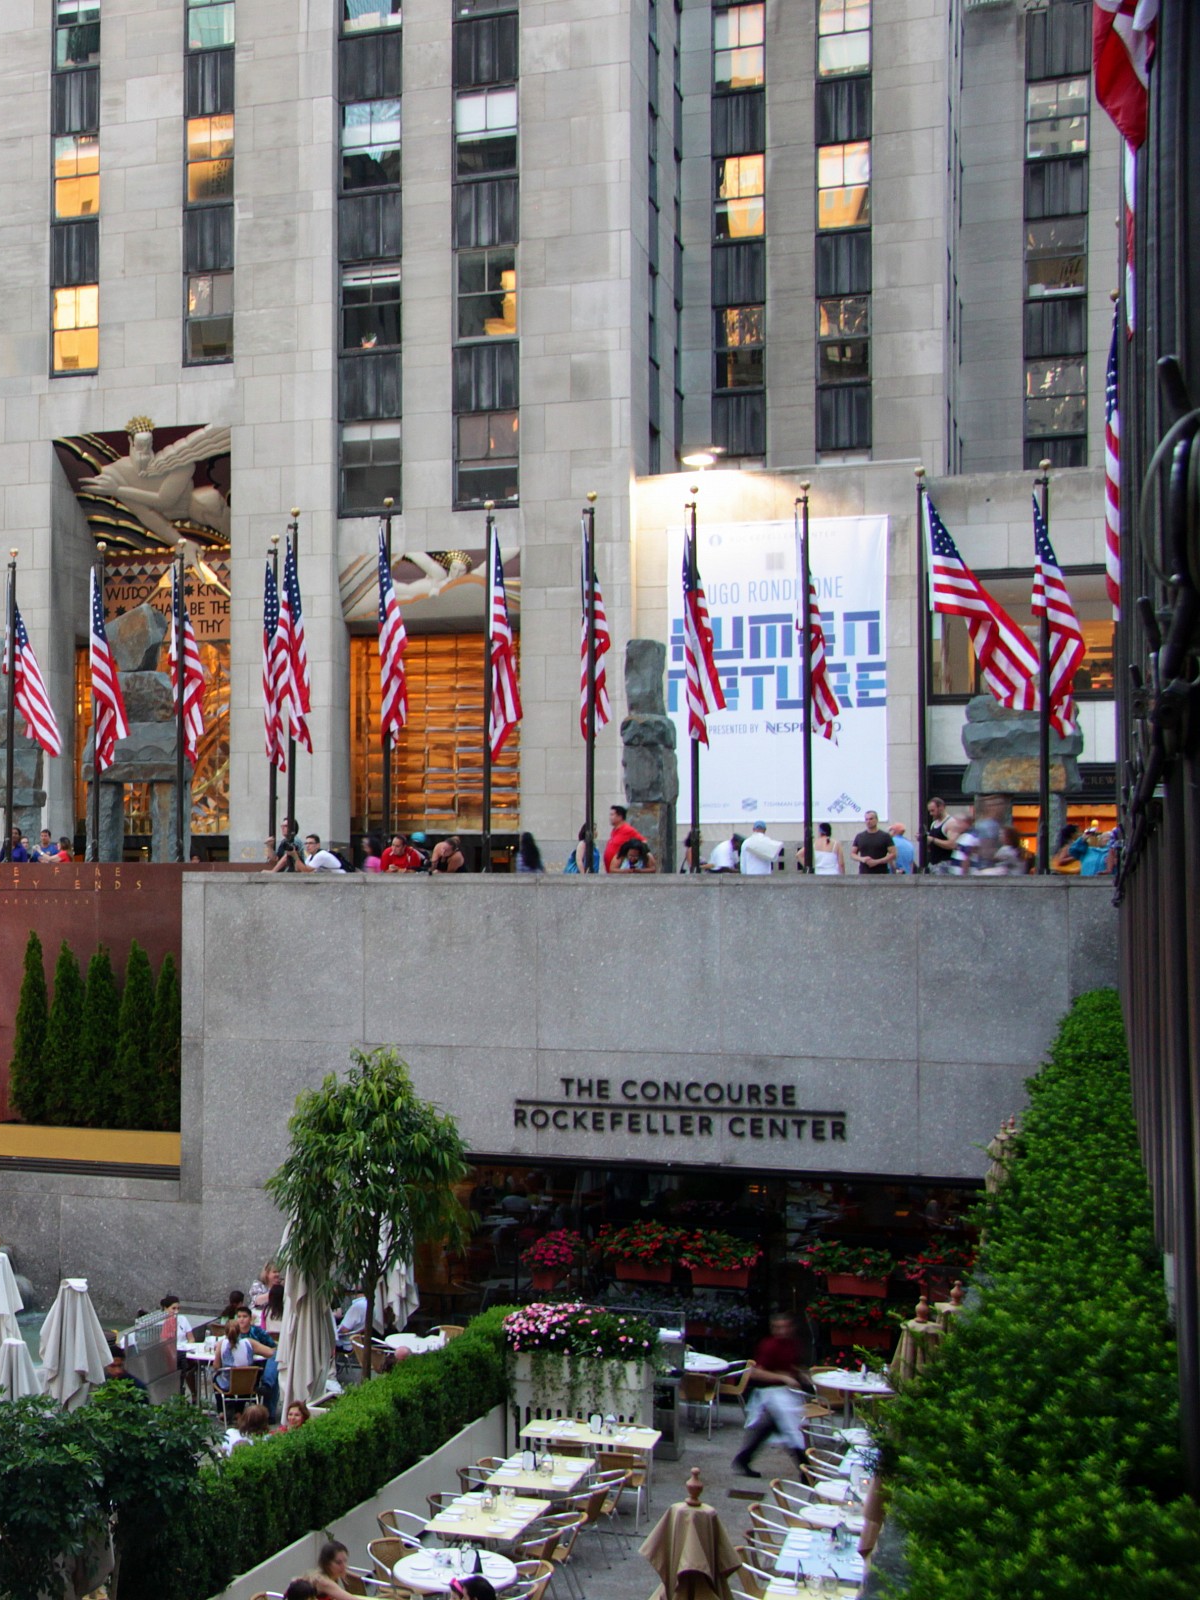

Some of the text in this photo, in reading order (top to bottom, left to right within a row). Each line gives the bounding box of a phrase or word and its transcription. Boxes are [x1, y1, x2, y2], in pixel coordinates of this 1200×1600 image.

[708, 575, 844, 605] UGO RONDIONE
[190, 601, 205, 616] BE
[210, 600, 230, 615] THE
[198, 618, 225, 634] THY
[708, 720, 842, 736] PRESENTED BY NESPO
[53, 866, 121, 877] FIRE
[74, 880, 143, 890] ENDS
[560, 1078, 796, 1106] THE CONCOURSE
[514, 1108, 846, 1142] ROCKEFELLER CENTER
